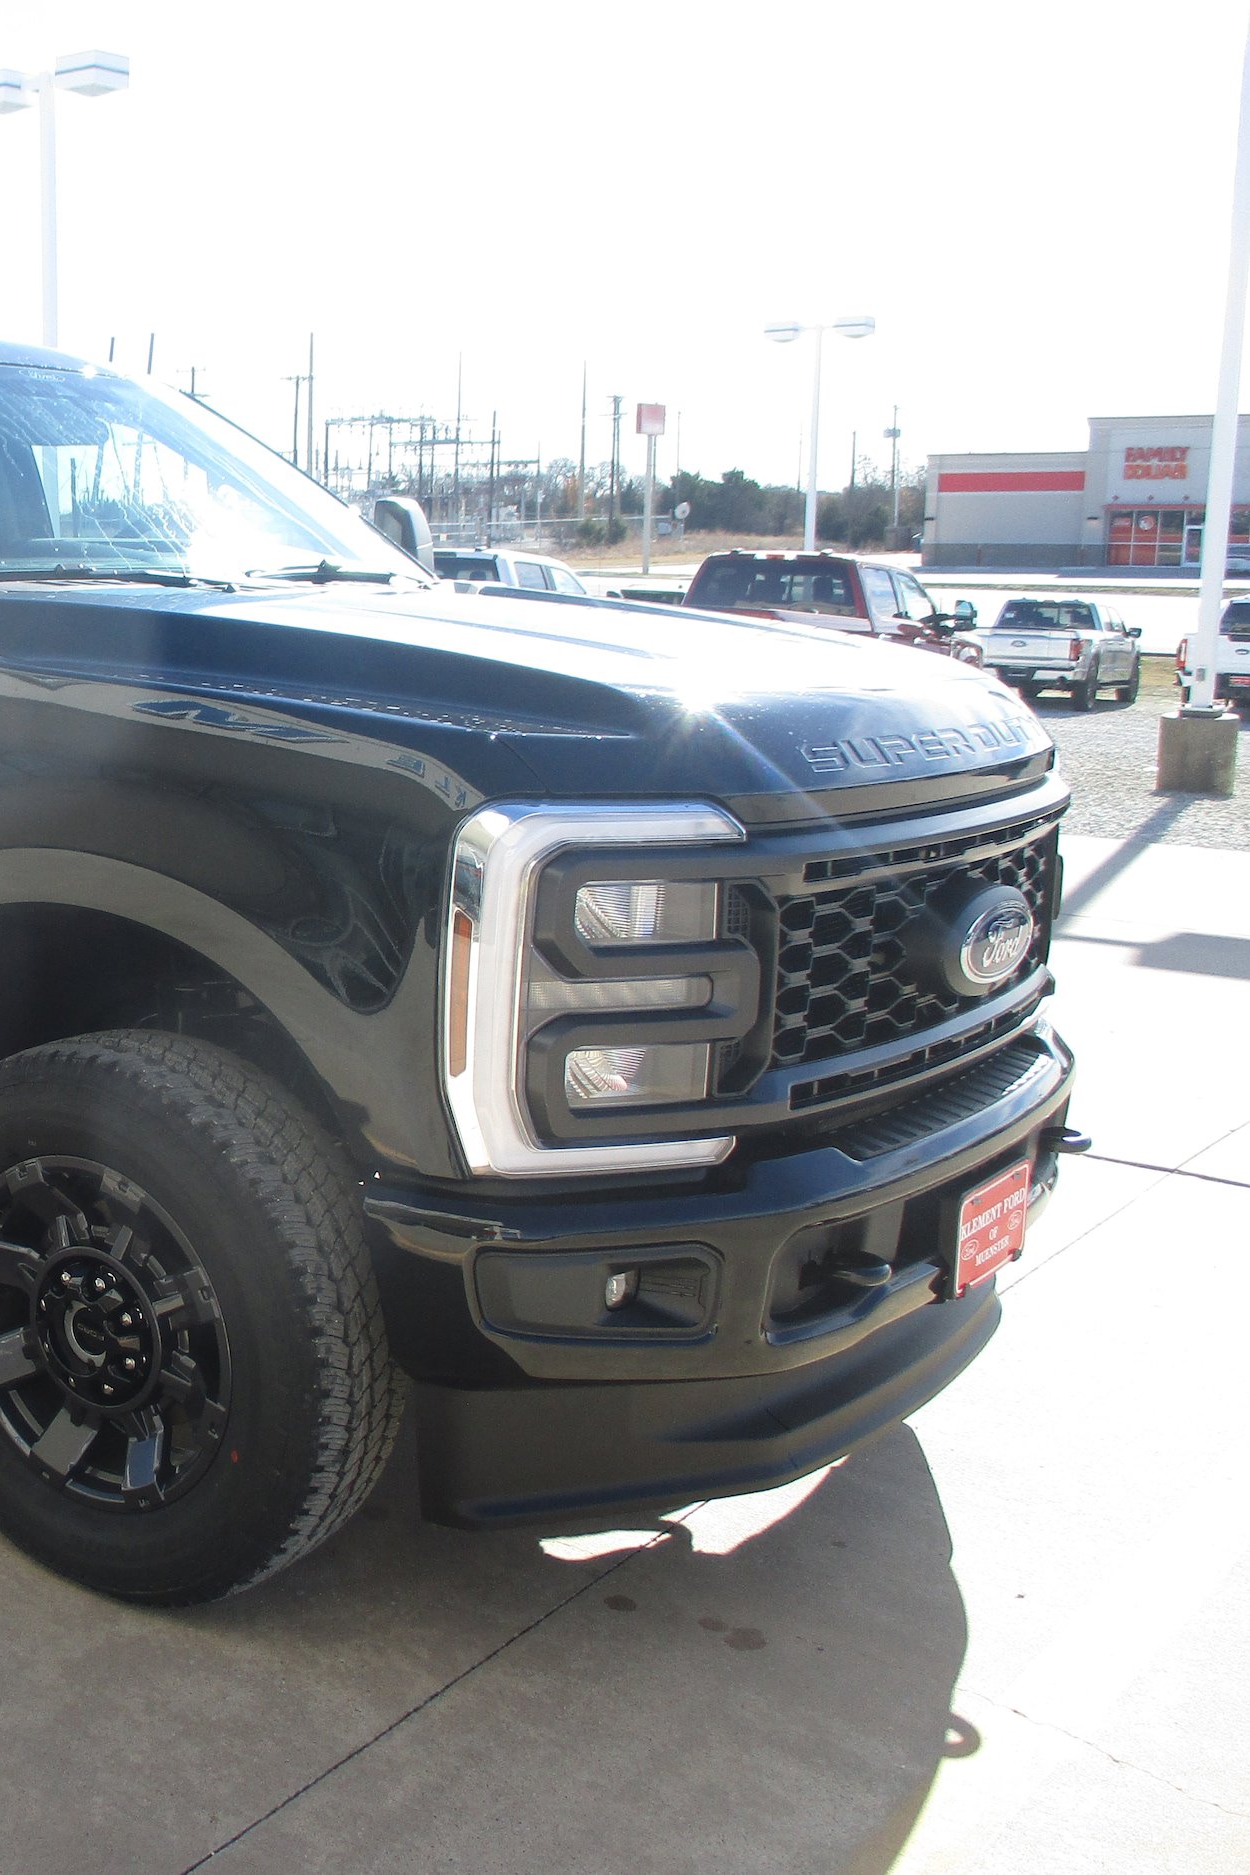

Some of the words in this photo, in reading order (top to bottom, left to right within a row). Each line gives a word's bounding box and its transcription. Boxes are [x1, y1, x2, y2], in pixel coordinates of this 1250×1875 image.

[1124, 447, 1190, 463] FAMILY
[1123, 464, 1188, 480] DOLLAR
[799, 728, 976, 773] SUPER
[982, 918, 1023, 968] Ford
[960, 1202, 1003, 1240] KLEMENT
[1003, 1187, 1025, 1214] FORD
[988, 1226, 998, 1241] OF
[974, 1235, 1010, 1267] MUENSTER
